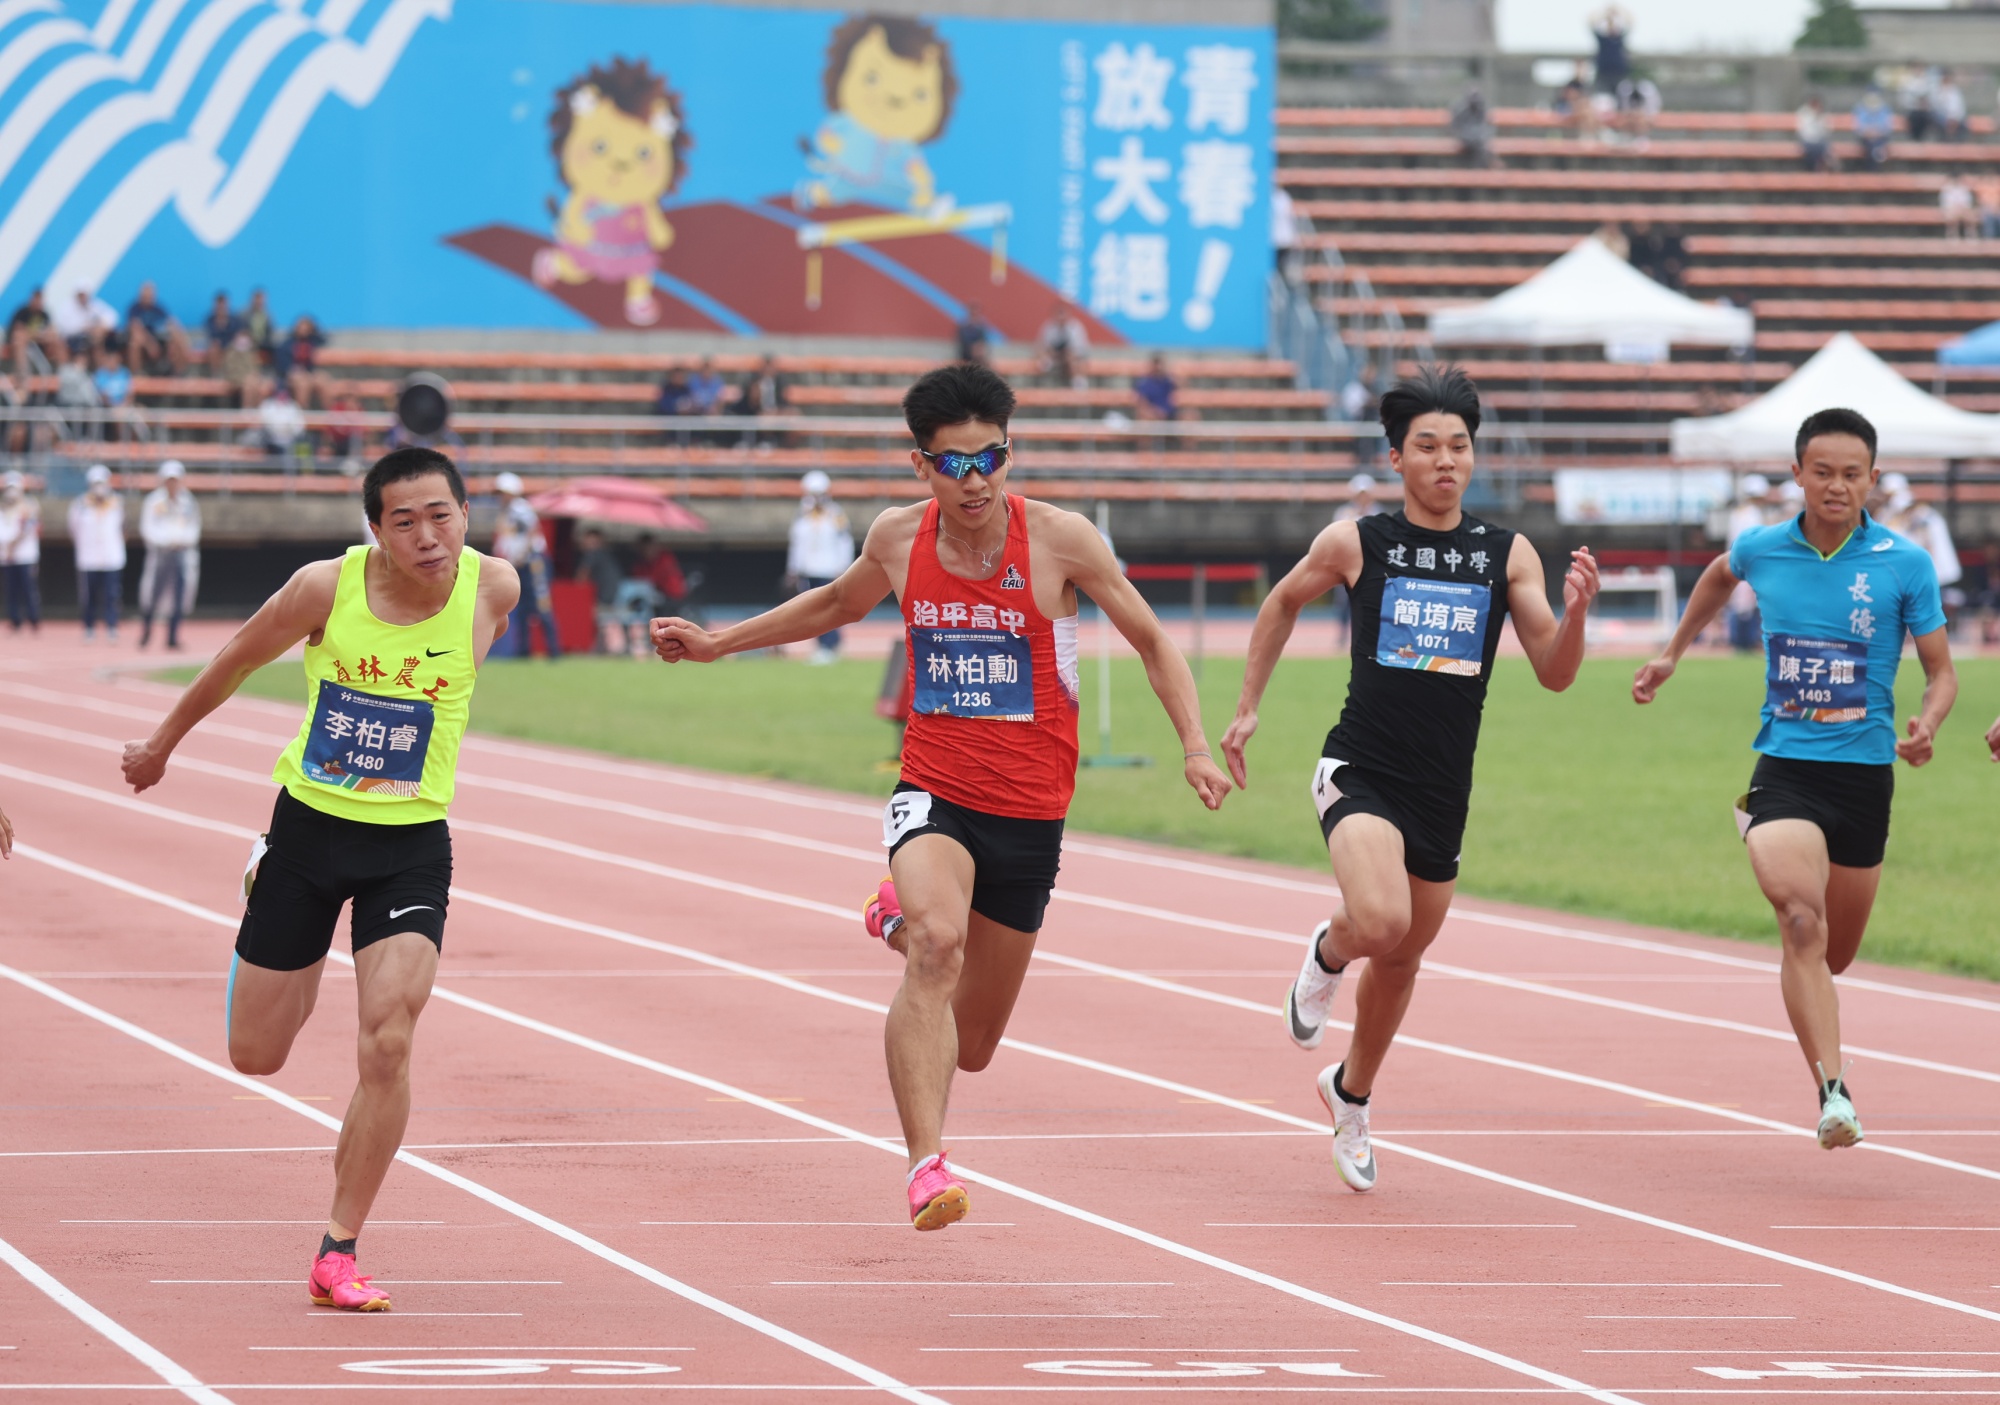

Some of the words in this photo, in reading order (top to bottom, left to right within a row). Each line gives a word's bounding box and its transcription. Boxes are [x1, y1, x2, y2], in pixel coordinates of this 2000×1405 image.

[1091, 42, 1174, 320] 放大絕
[1387, 543, 1490, 574] 建國中學
[1001, 578, 1026, 590] EALI
[913, 600, 1026, 633] 治平高中
[1393, 598, 1478, 634] 簡堉宸
[1848, 572, 1877, 638] 長億
[1415, 633, 1450, 650] 1071
[333, 655, 449, 701] 員林農工
[926, 653, 1018, 685] 林柏勳
[1778, 655, 1855, 684] 陳子龍
[952, 692, 992, 707] 1236
[1798, 688, 1832, 703] 1403
[325, 709, 418, 752] 李柏睿
[345, 750, 385, 771] 1480
[892, 801, 910, 830] 5
